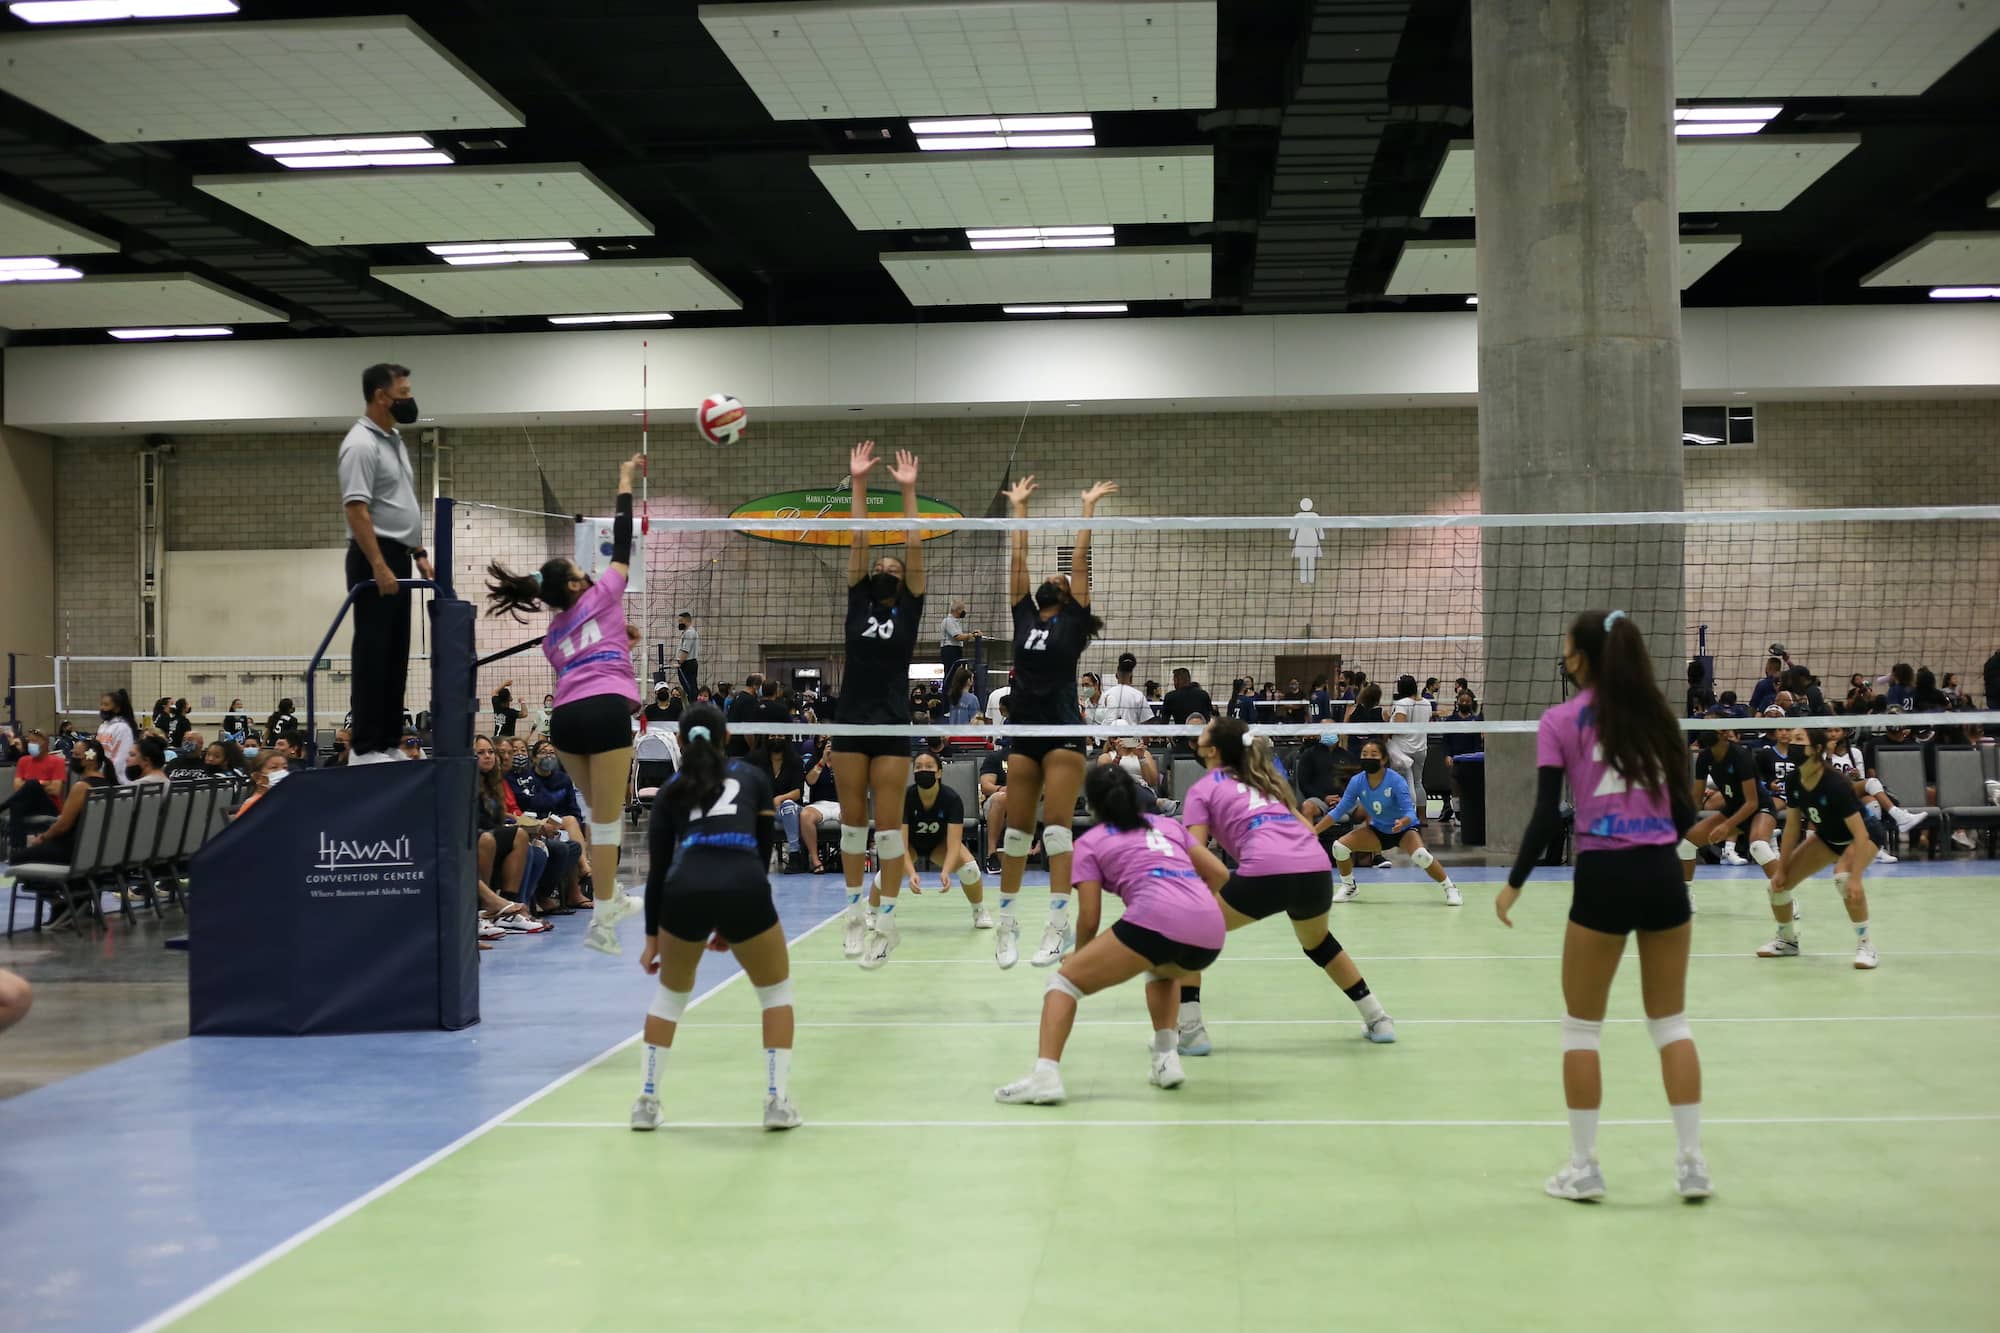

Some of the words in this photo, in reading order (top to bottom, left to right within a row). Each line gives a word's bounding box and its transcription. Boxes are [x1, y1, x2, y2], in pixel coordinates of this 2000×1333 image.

[866, 496, 884, 505] ENTER
[861, 616, 895, 640] 20
[274, 719, 284, 734] 5
[1725, 784, 1733, 799] 4
[1372, 801, 1383, 815] 9
[1808, 806, 1822, 824] 8
[915, 821, 940, 834] 29
[1146, 828, 1174, 857] 4
[305, 873, 378, 884] CONVENTION
[383, 871, 425, 881] CENTER
[310, 889, 335, 898] Where
[336, 888, 365, 897] Business
[366, 887, 379, 896] and
[381, 886, 400, 895] Aloha
[402, 885, 421, 895] Meet
